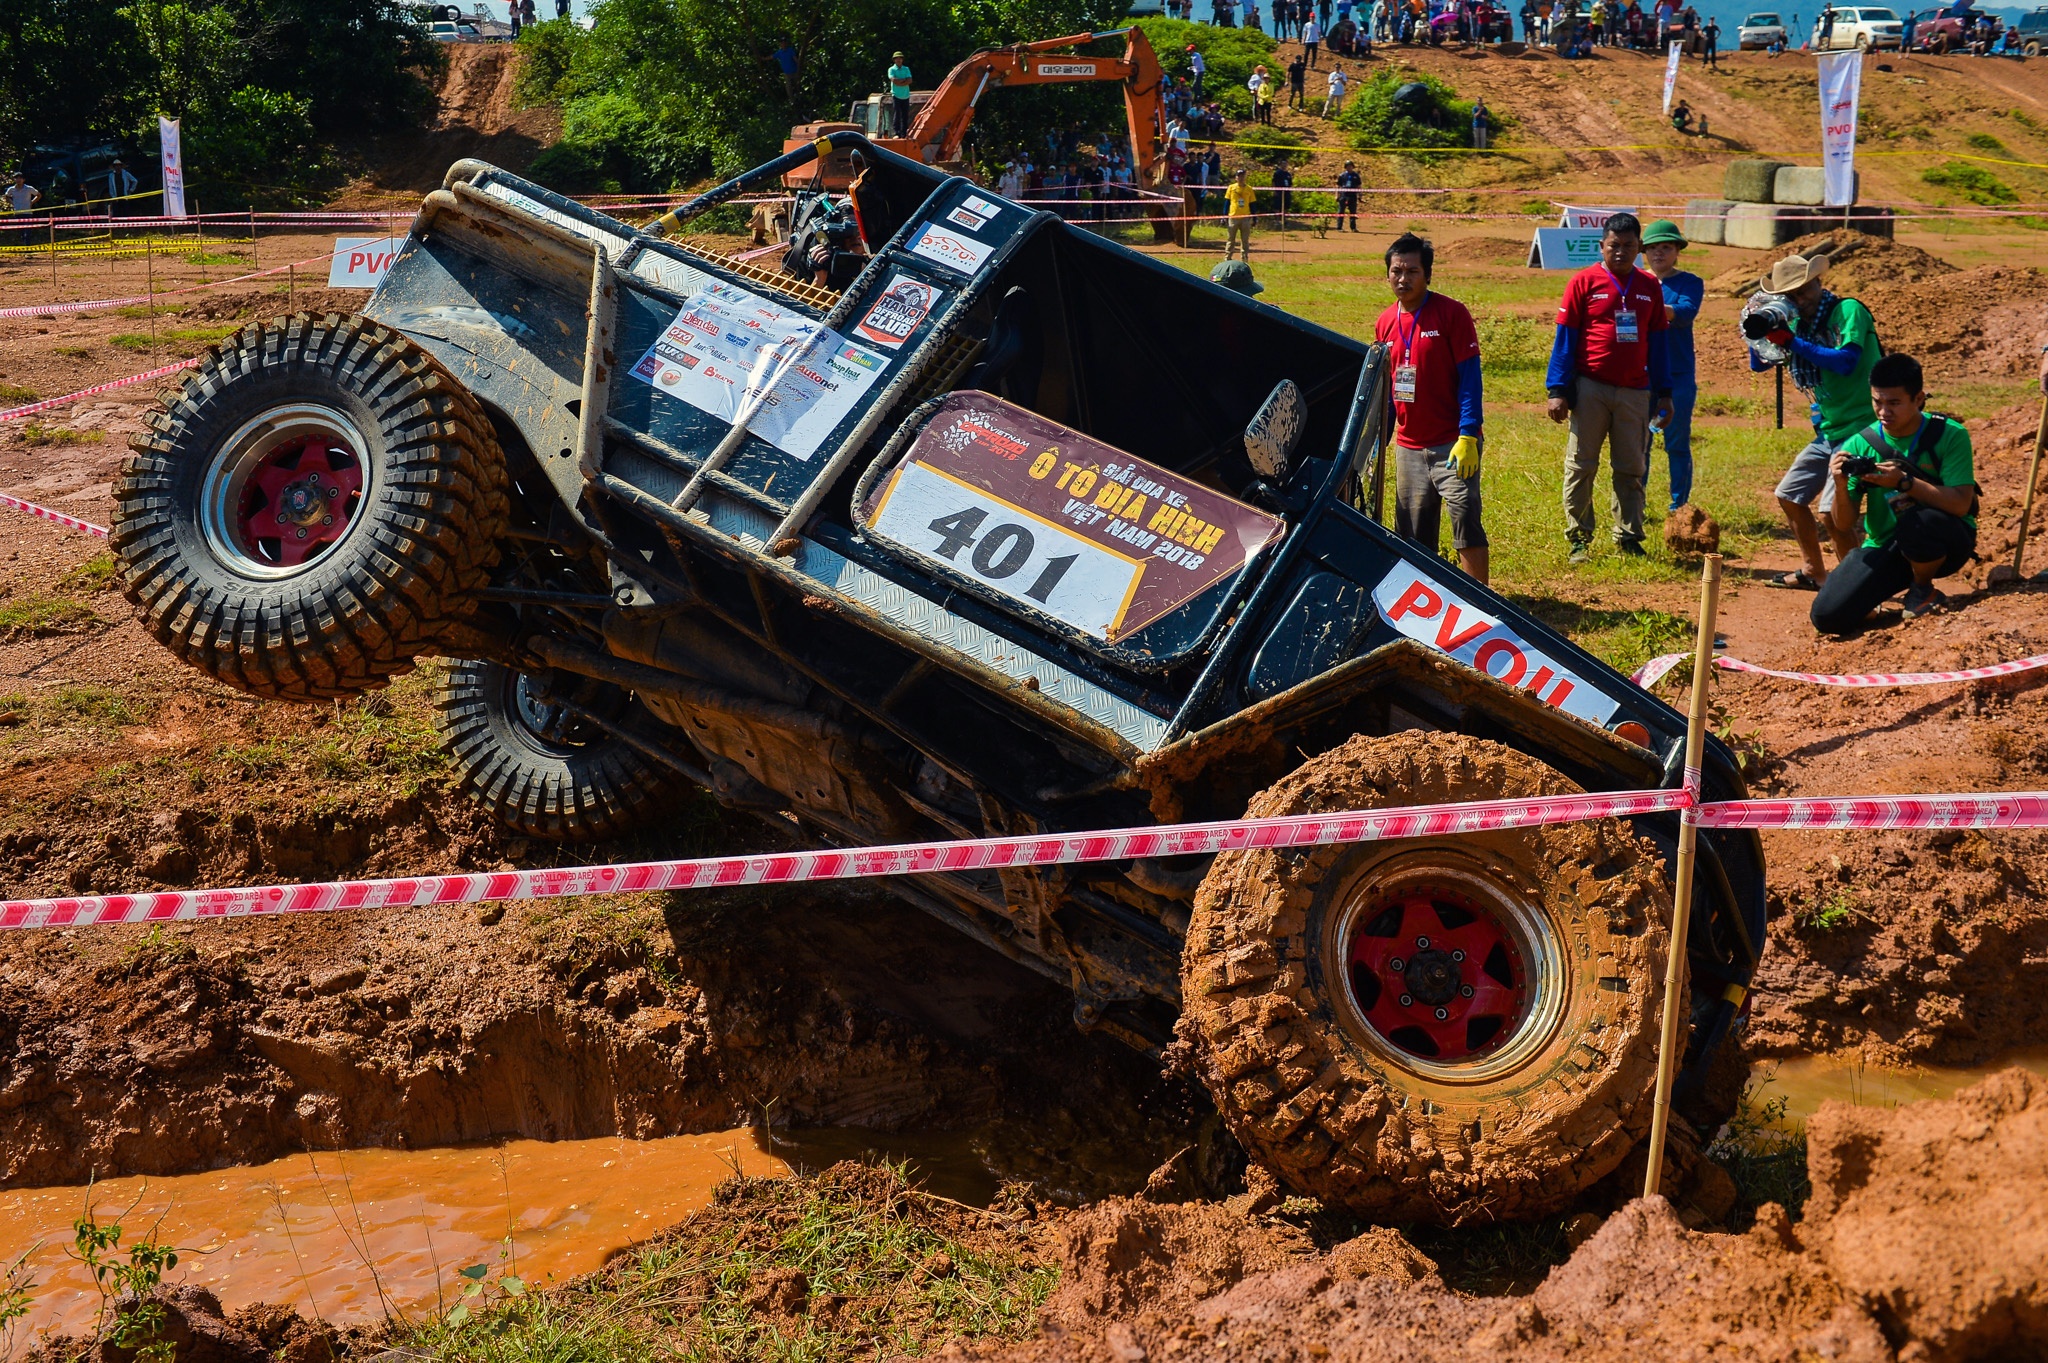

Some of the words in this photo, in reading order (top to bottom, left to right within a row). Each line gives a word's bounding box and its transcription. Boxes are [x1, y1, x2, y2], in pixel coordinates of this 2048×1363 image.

[1042, 65, 1093, 74] 대우굴삭기
[874, 306, 918, 327] OFFROAD
[880, 296, 923, 319] HANOI
[866, 313, 911, 337] CLUB
[1421, 330, 1440, 338] PVOIL
[960, 421, 1028, 455] OFFROAD
[990, 426, 1030, 447] VIETNAM
[988, 445, 1017, 460] 2018
[1029, 446, 1059, 480] Ô
[1055, 461, 1100, 498] TÔ
[1094, 480, 1148, 523] ĐỊA
[1147, 503, 1225, 556] HÌNH
[1061, 499, 1103, 527] VIỆT
[1104, 518, 1156, 552] NAM
[1153, 541, 1205, 573] 2018
[928, 505, 1081, 605] 401
